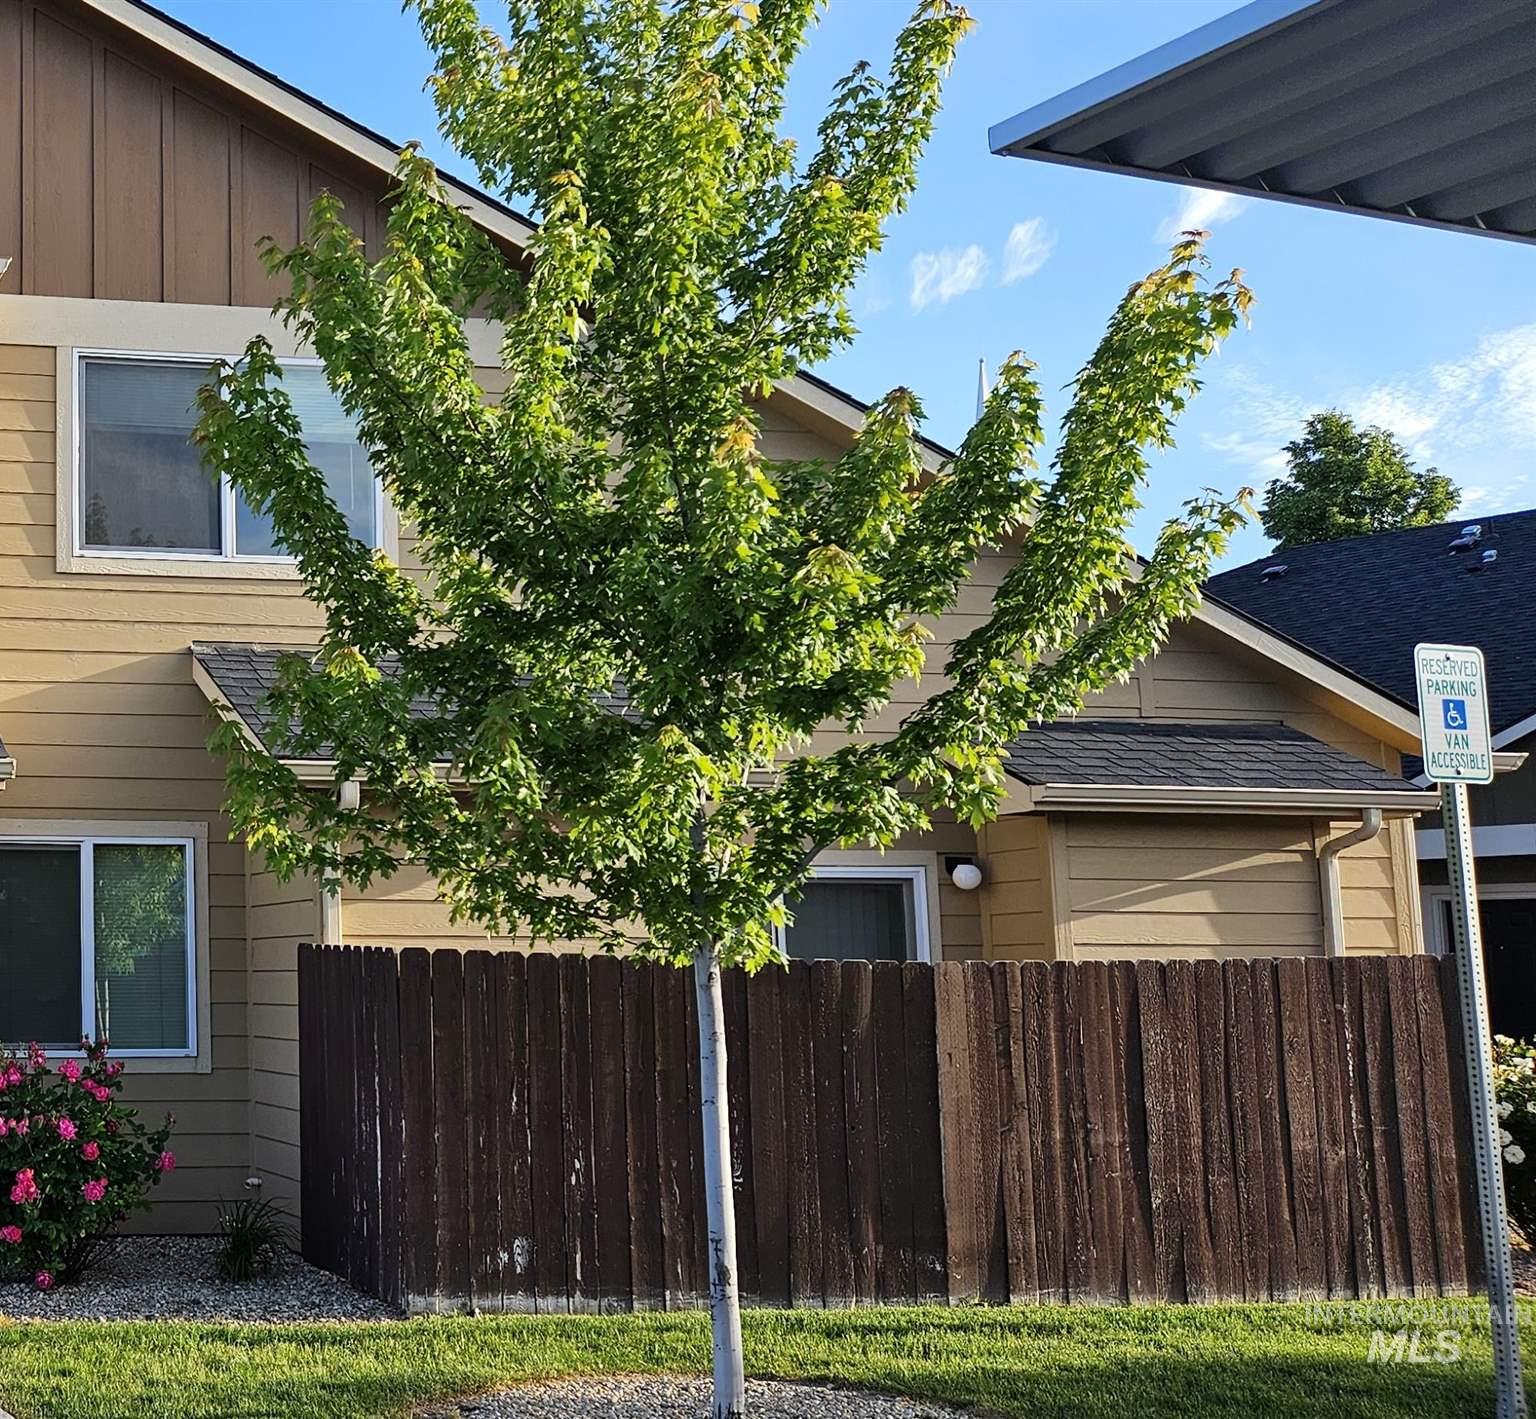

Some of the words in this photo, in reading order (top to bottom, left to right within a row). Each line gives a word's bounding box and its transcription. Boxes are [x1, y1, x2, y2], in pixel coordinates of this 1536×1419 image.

[1421, 658, 1478, 677] RESERVED
[1426, 678, 1477, 697] PARKING
[1444, 733, 1470, 750] VAN
[1430, 752, 1487, 770] ACCESSIBLE
